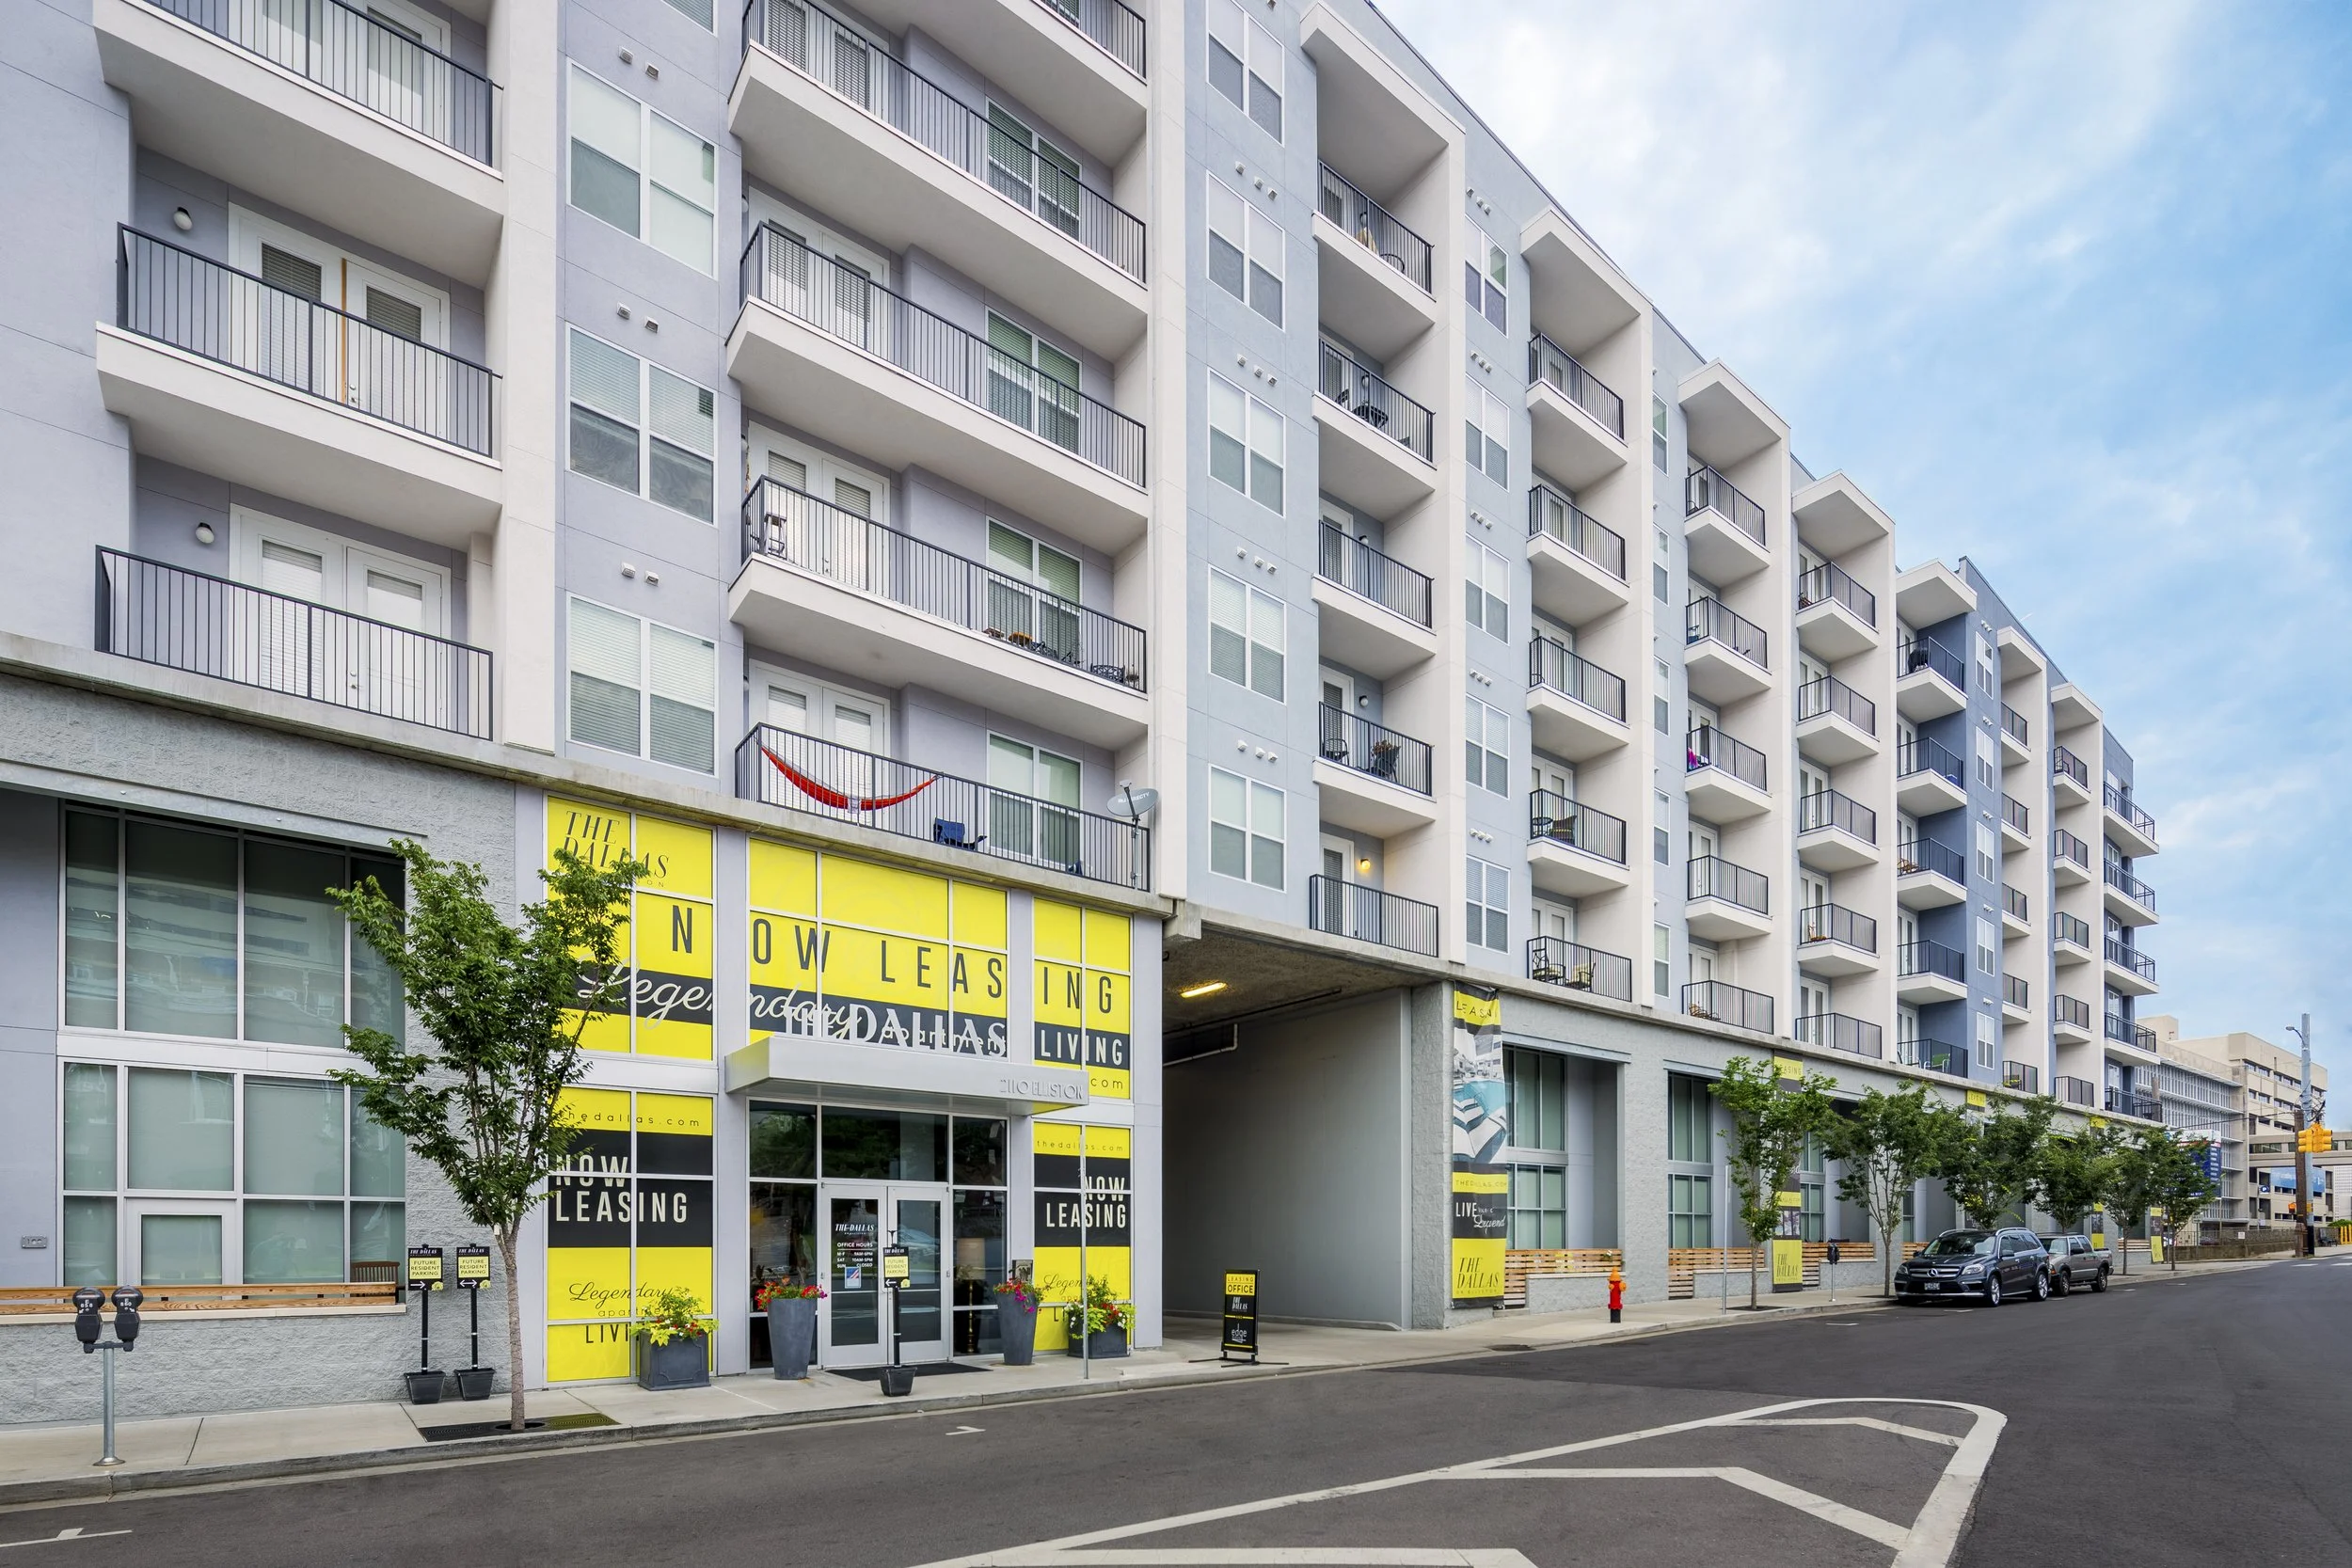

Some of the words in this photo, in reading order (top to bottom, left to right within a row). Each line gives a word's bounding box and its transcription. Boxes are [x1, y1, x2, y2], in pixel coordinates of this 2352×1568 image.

[566, 811, 620, 844] THE
[882, 941, 1112, 1014] LEASING
[850, 1004, 1007, 1058] DALLAS
[1041, 1029, 1122, 1066] LIVING
[1032, 1081, 1083, 1100] ELLISTON
[567, 1111, 700, 1127] hedallas.com
[556, 1154, 628, 1187] NOW
[1085, 1176, 1125, 1202] NOW
[556, 1190, 687, 1224] LEASING
[1046, 1202, 1126, 1228] LEASING
[1455, 1202, 1477, 1217] LIVE
[1459, 1257, 1483, 1273] THE
[1227, 1284, 1253, 1293] OFFICE
[1457, 1273, 1500, 1290] DALLAS
